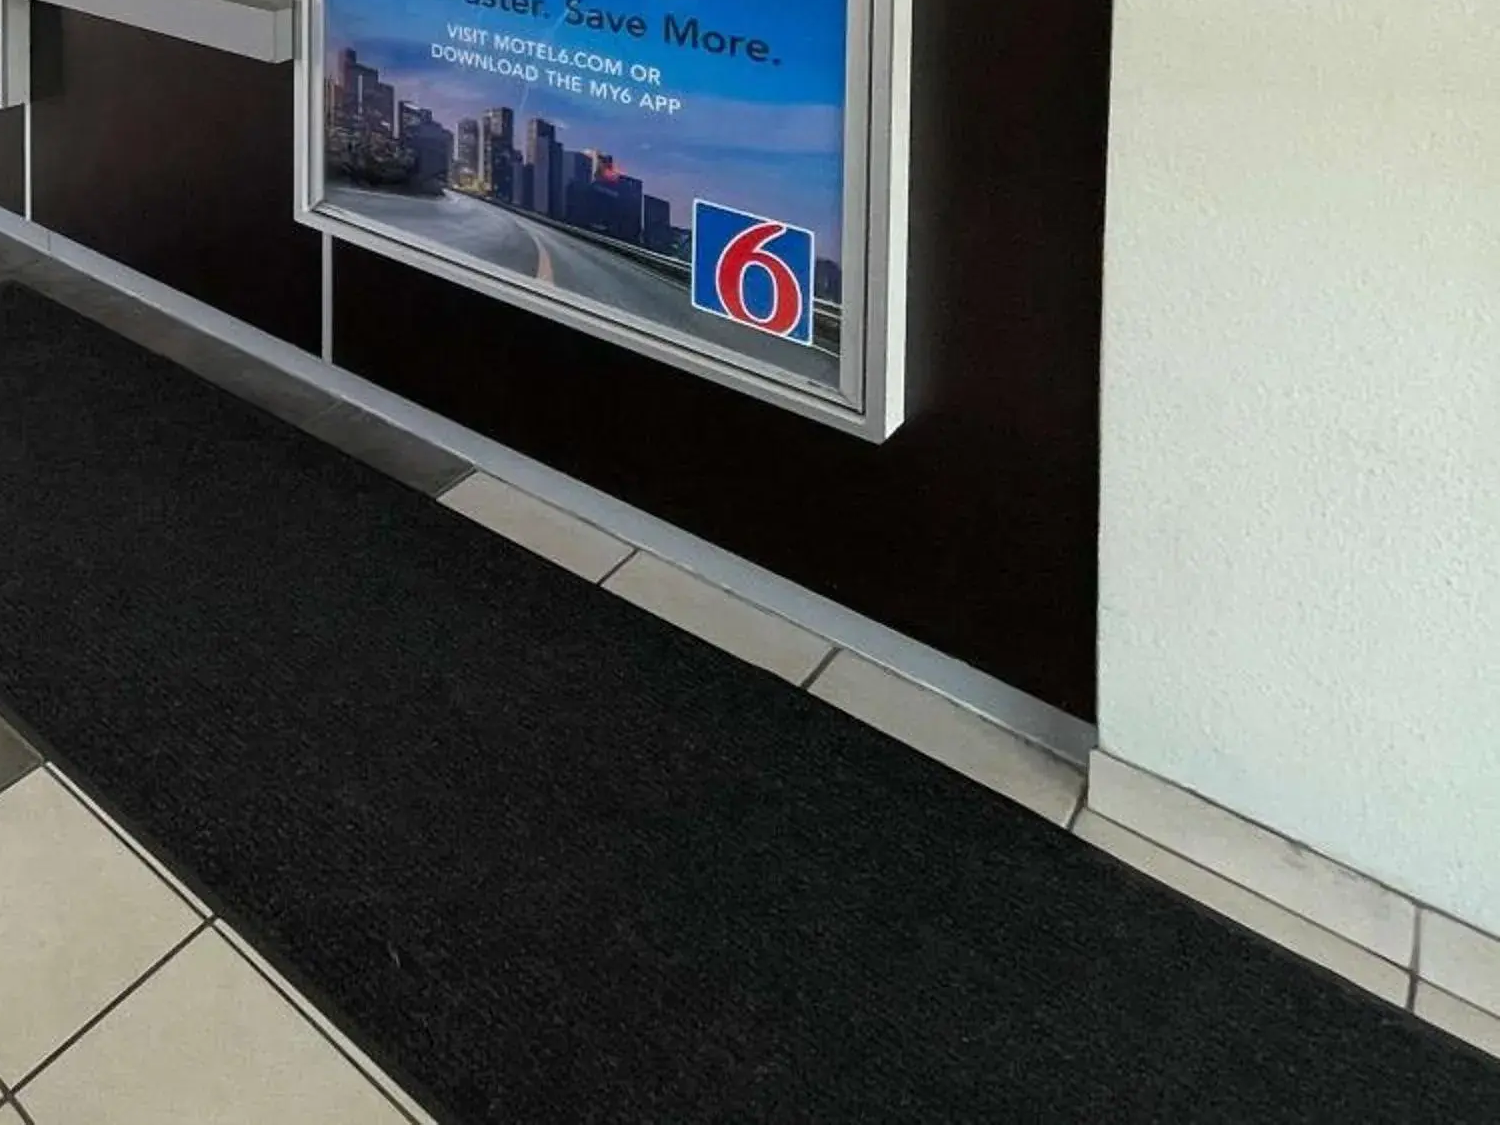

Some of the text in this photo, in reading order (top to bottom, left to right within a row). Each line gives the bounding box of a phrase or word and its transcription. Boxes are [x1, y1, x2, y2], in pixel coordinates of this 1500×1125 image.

[447, 22, 662, 86] VISIT MOTEL6.COM OR
[664, 13, 782, 66] More.
[431, 44, 681, 114] DOWNLOAD THE MY6 APP
[715, 220, 803, 337] 6
